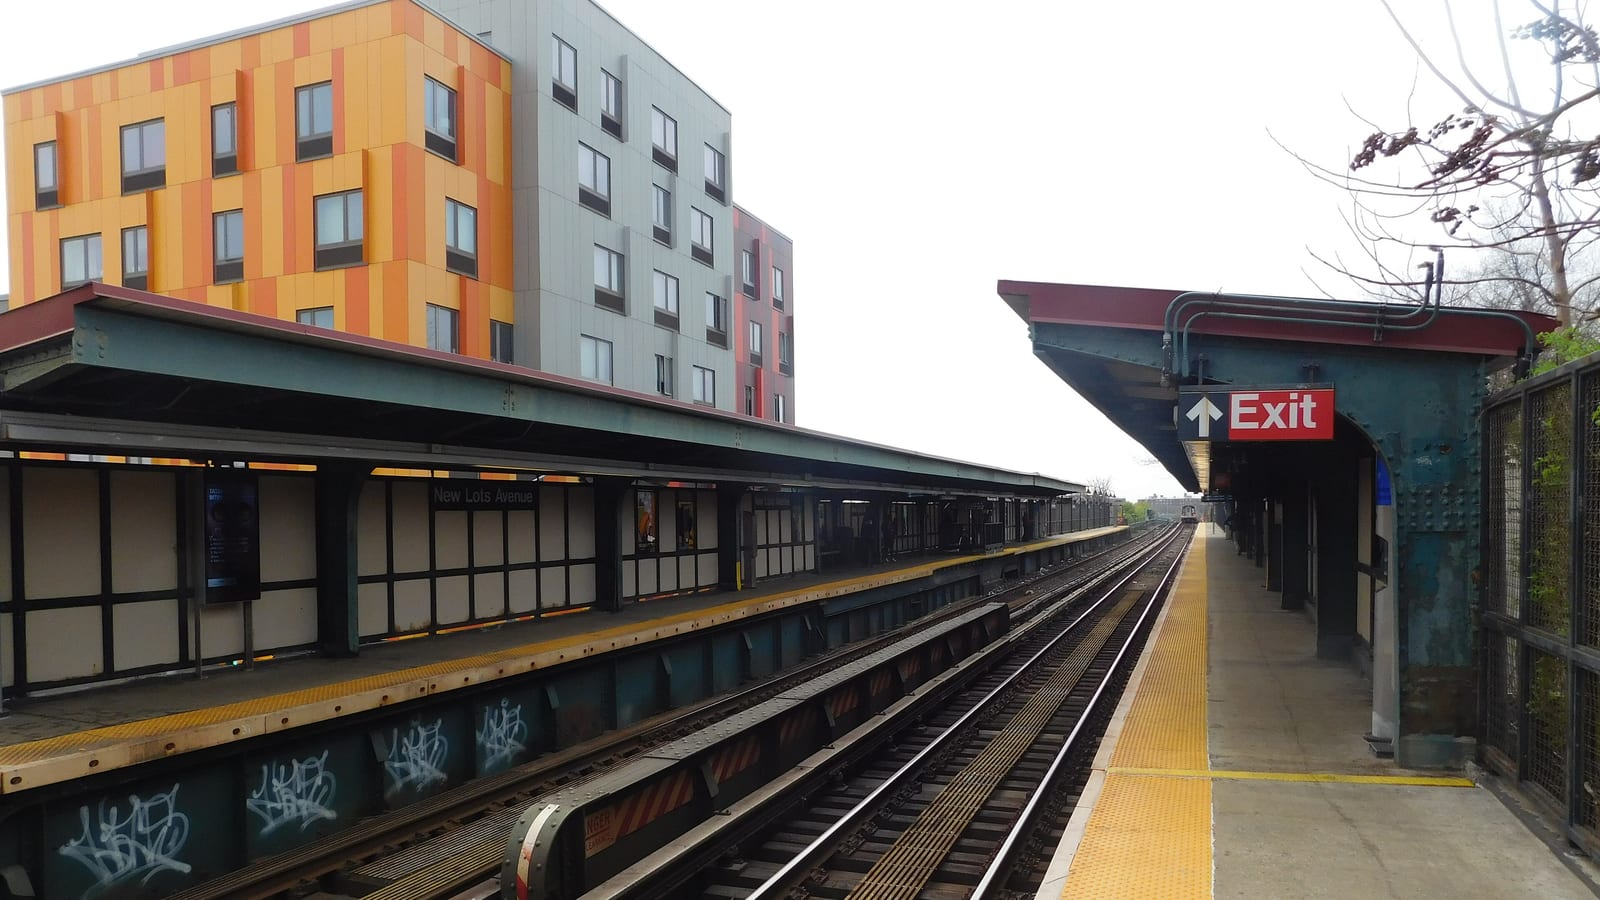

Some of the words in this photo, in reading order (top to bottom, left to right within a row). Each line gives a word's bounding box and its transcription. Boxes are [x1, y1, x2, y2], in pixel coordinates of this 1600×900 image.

[1230, 392, 1317, 429] Exit
[433, 486, 461, 503] New
[465, 487, 491, 503] Lots
[495, 487, 533, 503] Avenue
[586, 810, 610, 835] NGER
